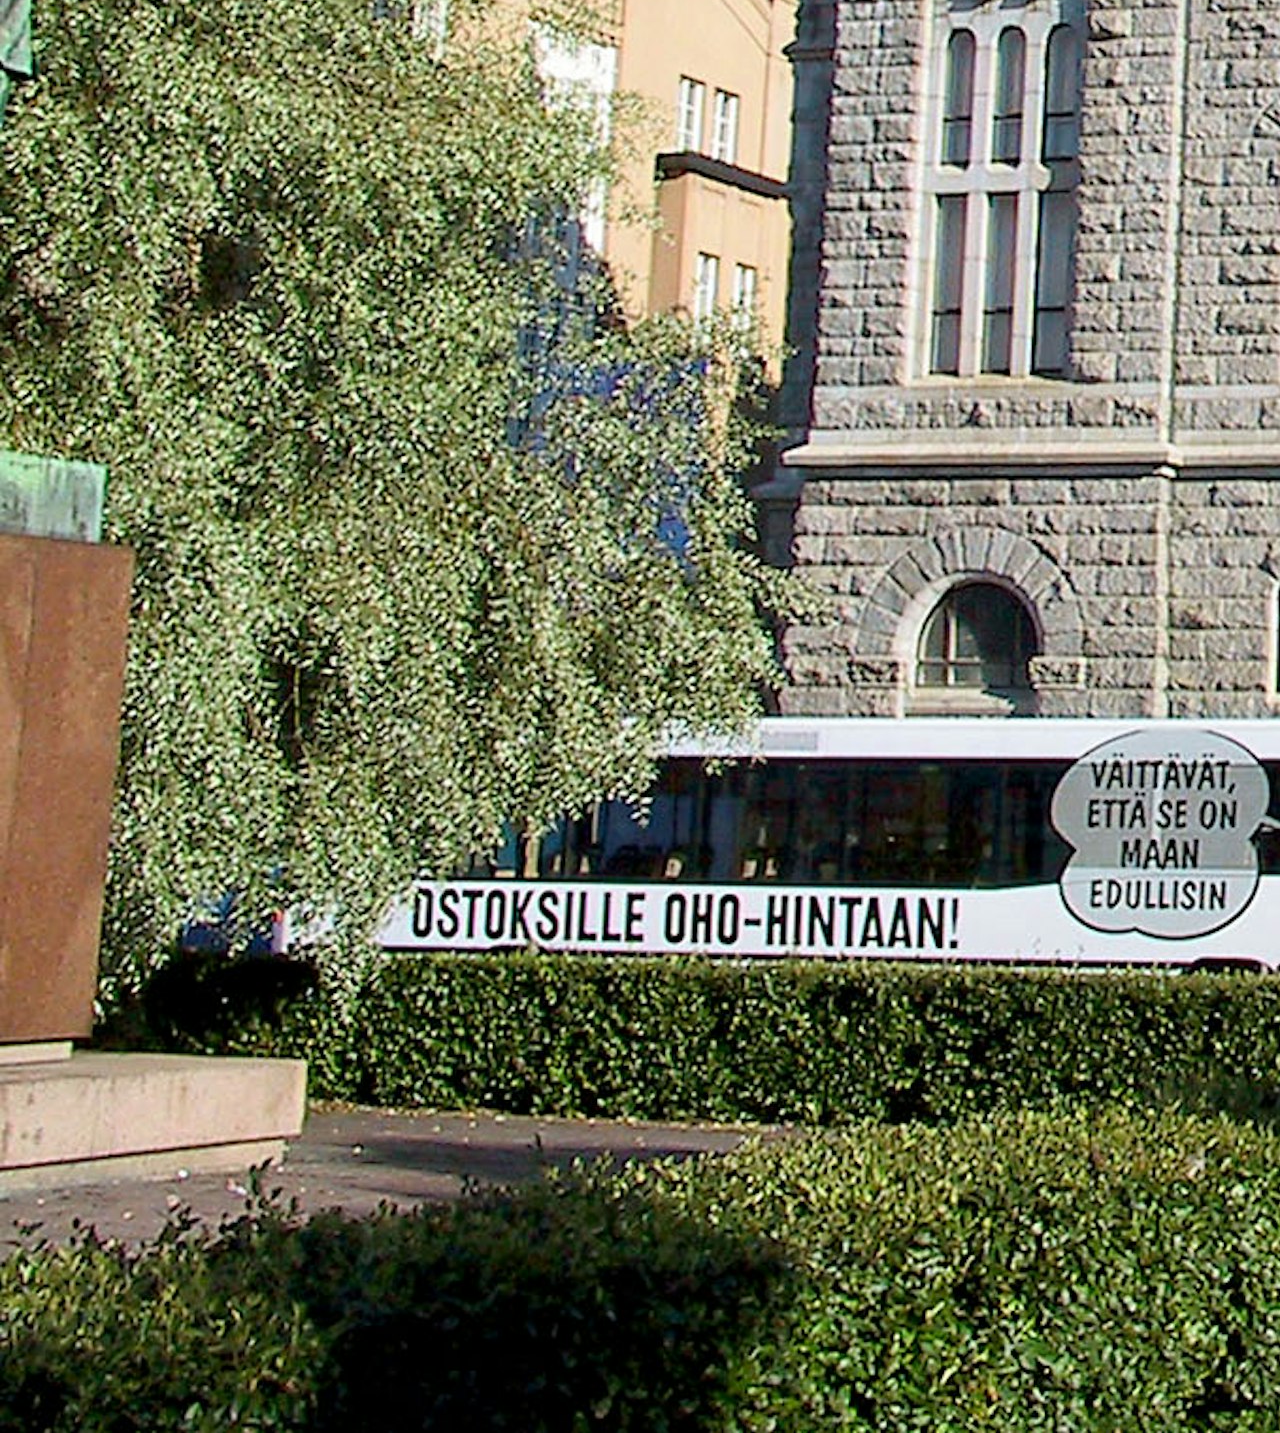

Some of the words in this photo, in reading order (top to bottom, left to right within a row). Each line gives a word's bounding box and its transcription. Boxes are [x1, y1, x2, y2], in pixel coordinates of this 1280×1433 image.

[1091, 752, 1236, 794] VÄITTÄVÄT,
[1088, 792, 1147, 829] ETTÄ
[1156, 800, 1188, 829] SE
[1200, 800, 1238, 830] ON
[1121, 839, 1199, 869] MAAN
[1090, 880, 1227, 910] EDULLISIN
[412, 888, 646, 943] OSTOKSILLE
[665, 893, 959, 949] OHO-HINTAAN!
